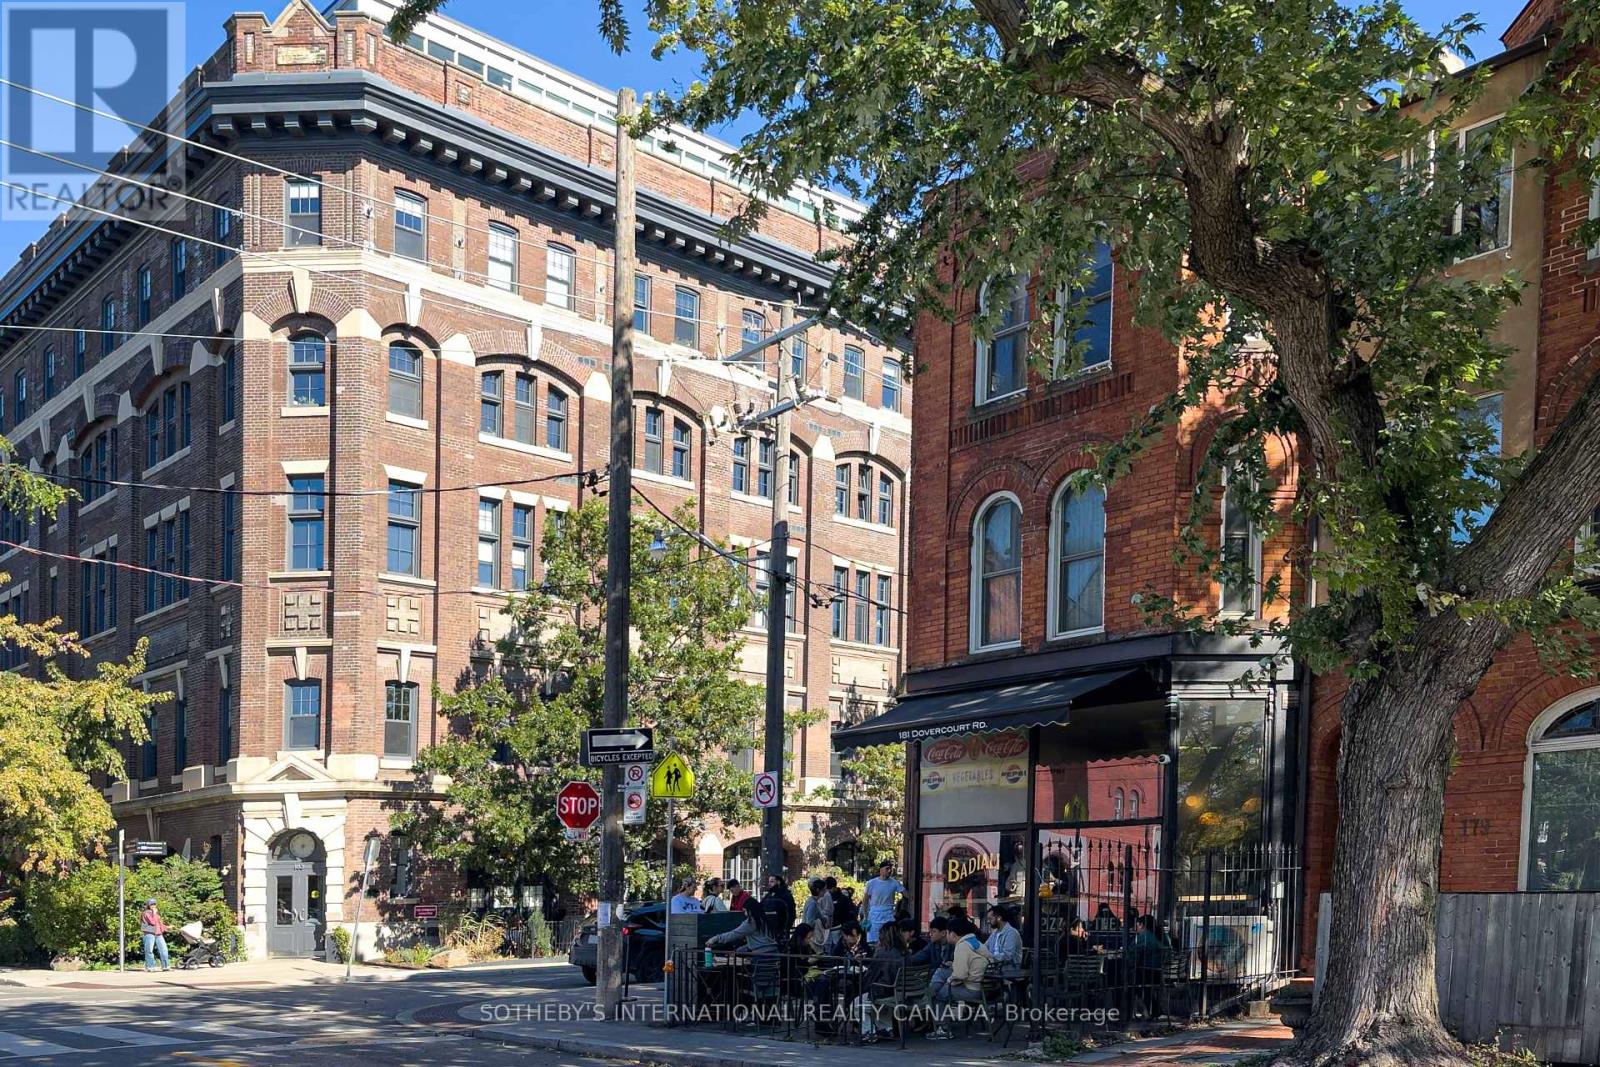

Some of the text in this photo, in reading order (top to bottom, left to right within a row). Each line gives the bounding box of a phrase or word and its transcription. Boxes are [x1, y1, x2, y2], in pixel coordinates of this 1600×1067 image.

[898, 721, 988, 739] 181 DOVERCOURT RD.
[590, 752, 653, 762] BICYCLES EXCEPTED
[560, 797, 597, 815] STOP
[947, 853, 1000, 883] BADIALI
